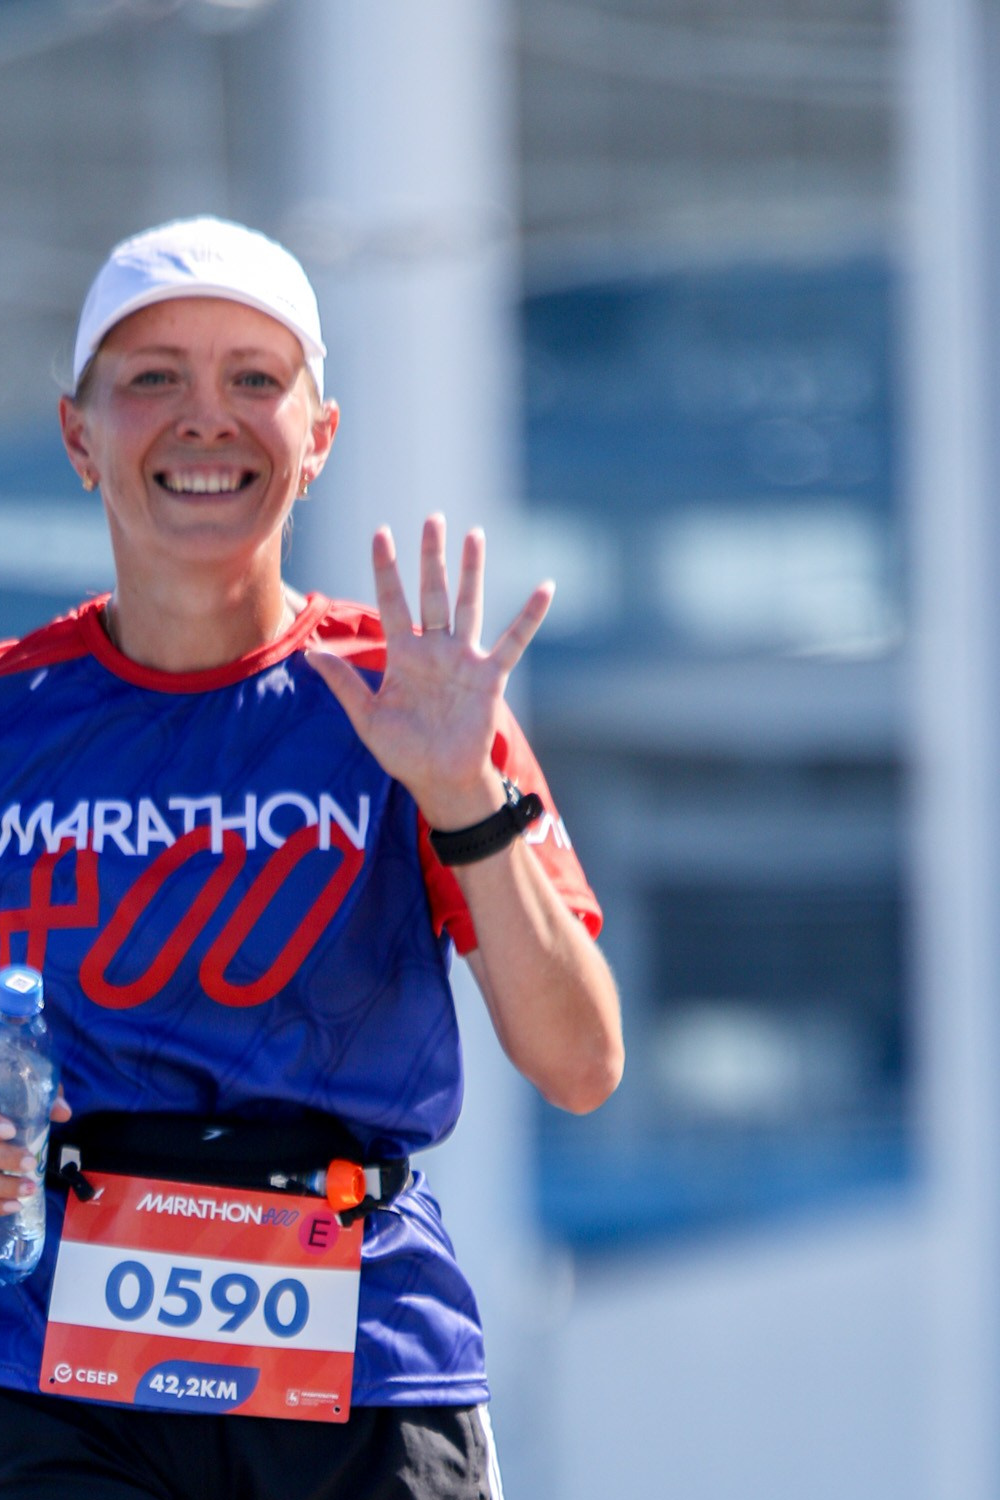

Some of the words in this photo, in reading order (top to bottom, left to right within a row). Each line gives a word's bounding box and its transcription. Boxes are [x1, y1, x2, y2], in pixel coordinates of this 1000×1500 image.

[136, 1193, 264, 1226] MARATHON
[308, 1218, 331, 1248] E
[104, 1260, 310, 1339] 0590
[75, 1367, 118, 1386] СБЕР
